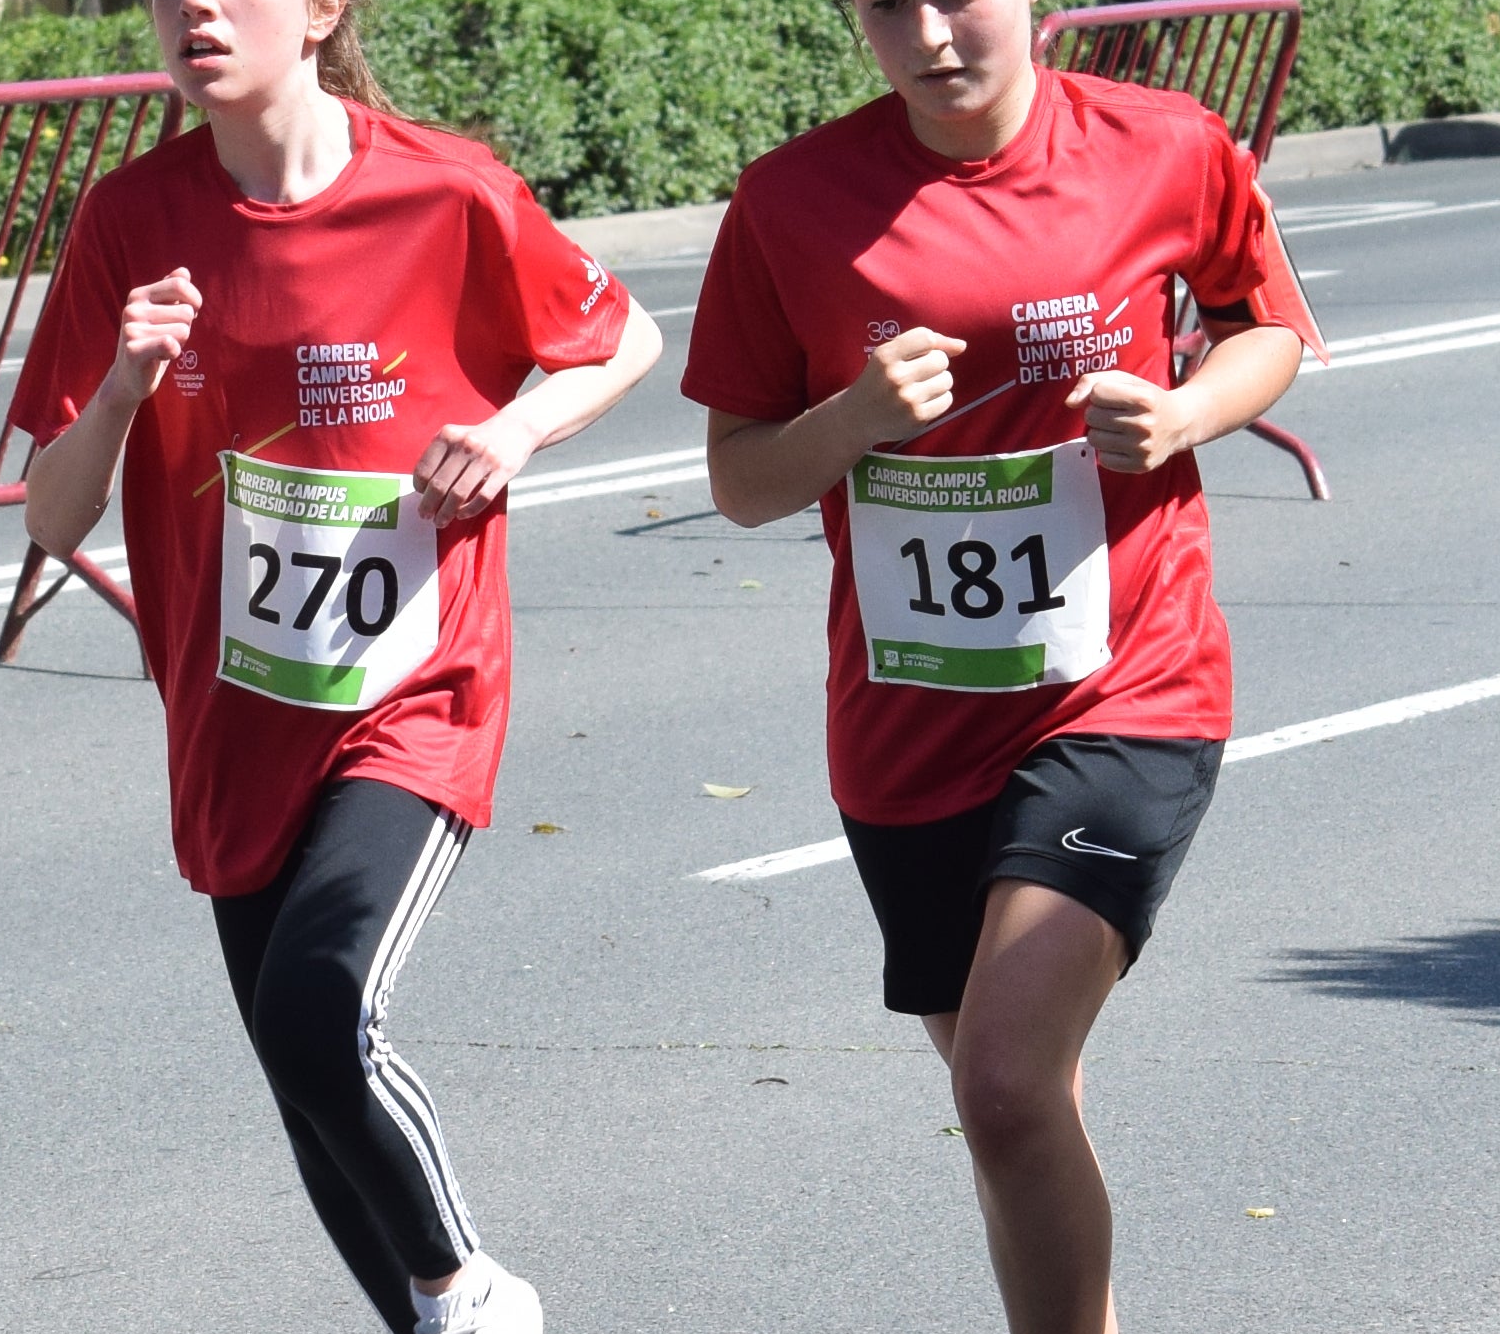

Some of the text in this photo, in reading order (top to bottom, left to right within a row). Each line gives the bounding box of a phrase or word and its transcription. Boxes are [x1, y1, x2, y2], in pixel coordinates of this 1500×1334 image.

[1011, 292, 1100, 323] CARRERA
[1015, 315, 1095, 344] CAMPUS
[296, 342, 380, 364] CARRERA
[1017, 326, 1133, 364] UNIVERSIDAD
[297, 363, 372, 385] CAMPUS
[1019, 350, 1119, 385] DE LA RIOJA
[298, 378, 406, 406] UNIVERSIDAD
[300, 400, 395, 427] DE LA RIOJA
[234, 470, 348, 503] CARRERA CAMPUS
[867, 465, 987, 489] CARRERA CAMPUS
[234, 485, 388, 523] UNIVERSIDAD DE LA RIOJA
[867, 482, 1040, 507] UNIVERSIDAD DE LA RIOJA
[248, 543, 399, 637] 270
[900, 533, 1066, 620] 181
